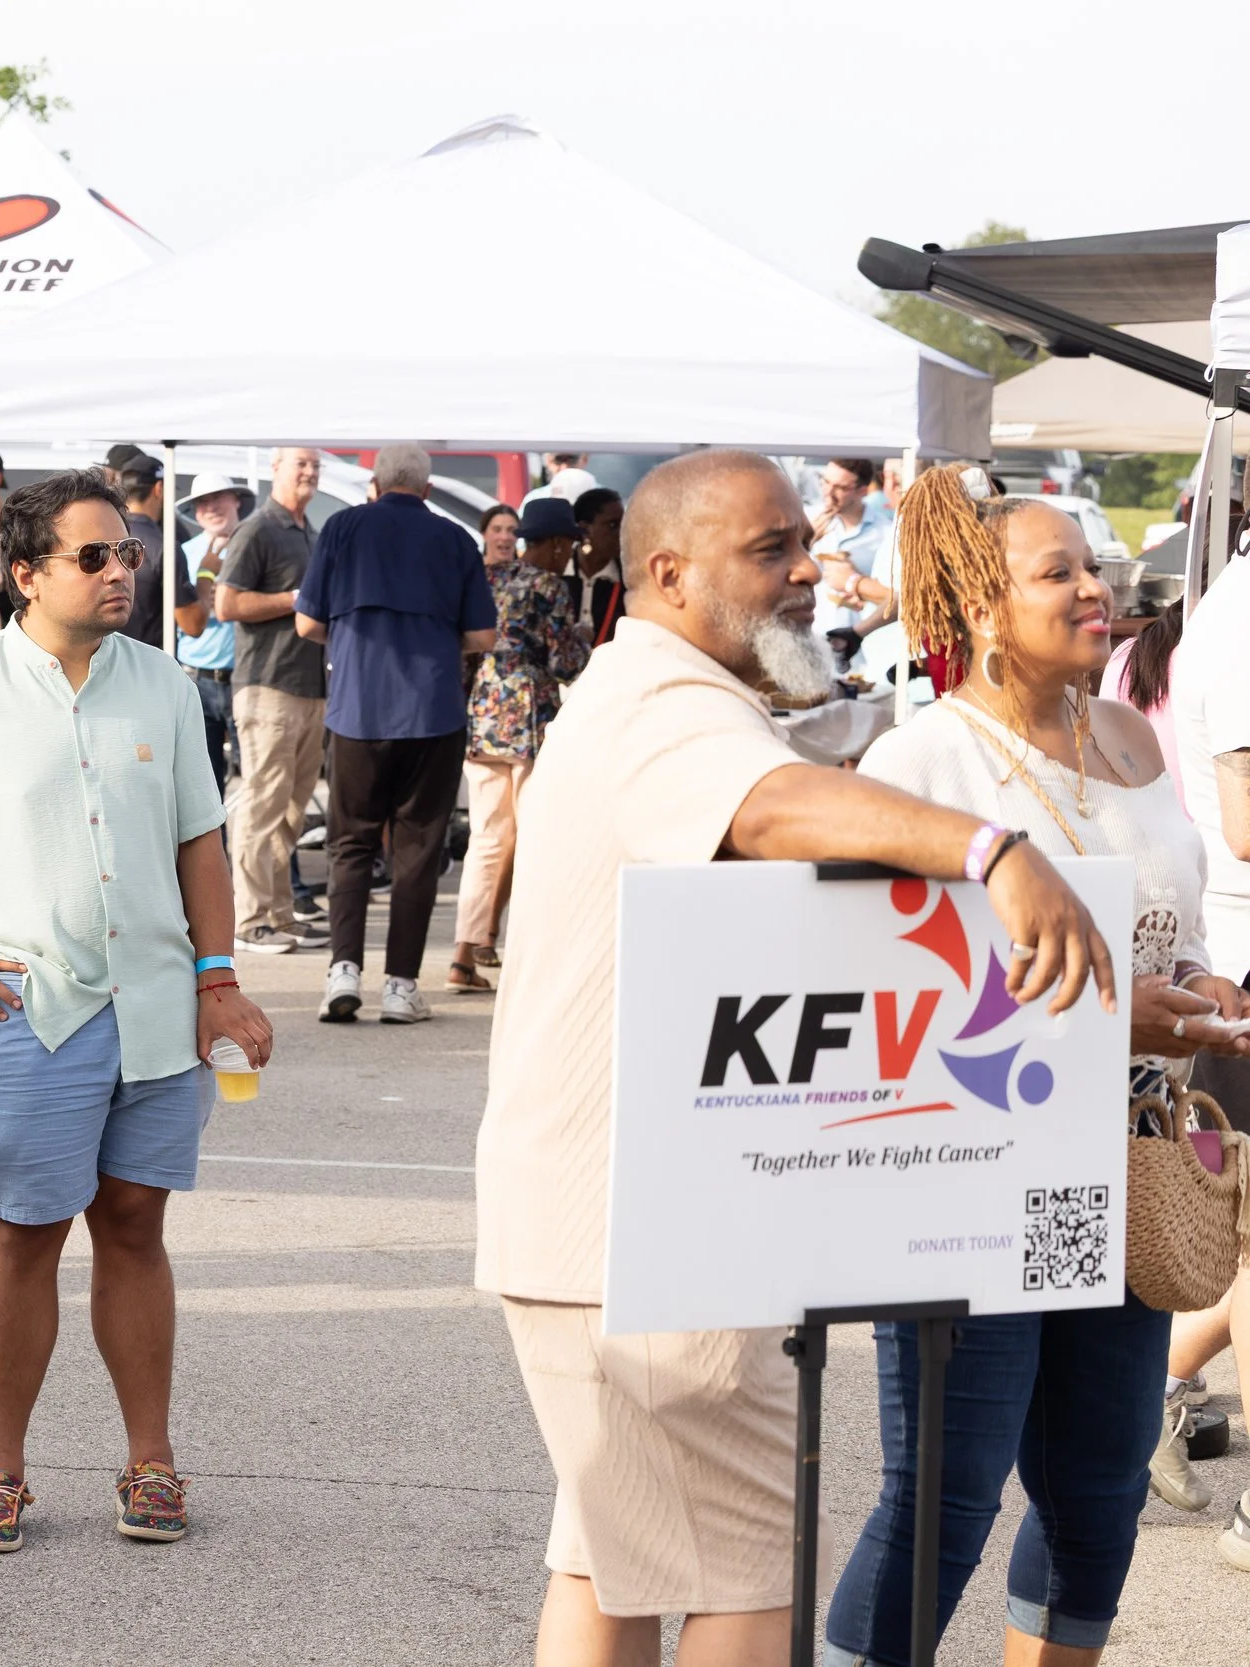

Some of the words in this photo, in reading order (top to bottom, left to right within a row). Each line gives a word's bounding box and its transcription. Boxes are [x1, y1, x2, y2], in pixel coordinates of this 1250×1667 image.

[699, 989, 943, 1088] KFV
[693, 1092, 801, 1109] KENTUCKIANA
[804, 1089, 869, 1105] FRIENDS
[871, 1088, 892, 1102] OF
[894, 1088, 905, 1101] V
[741, 1150, 841, 1177] "Together
[846, 1148, 876, 1168] We
[880, 1145, 933, 1171] Fight
[937, 1140, 1015, 1164] Cancer"
[908, 1236, 966, 1254] DONATE
[968, 1234, 1015, 1250] TODAY
